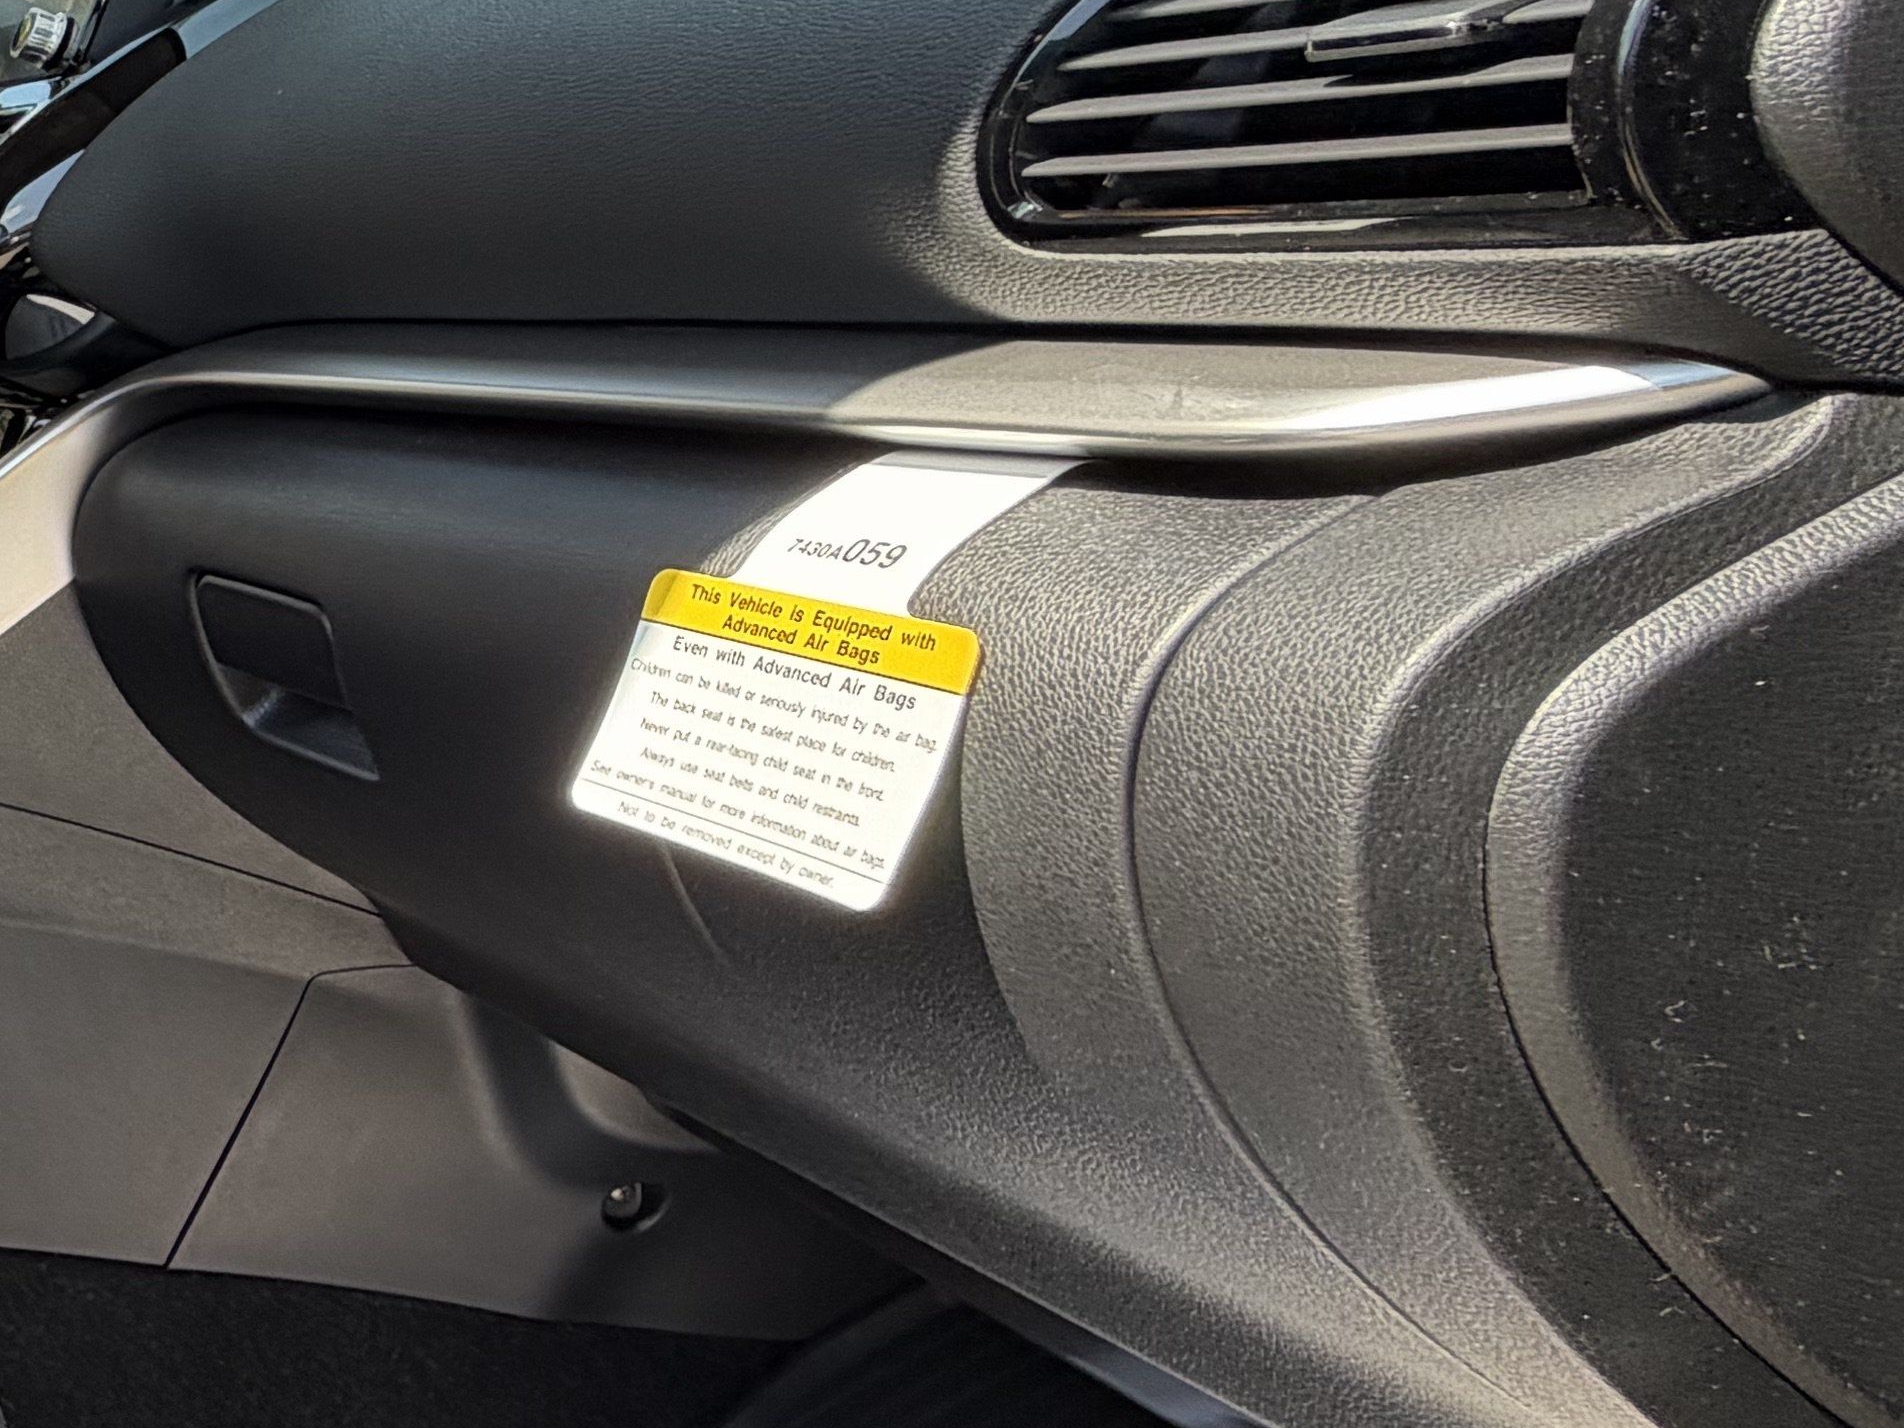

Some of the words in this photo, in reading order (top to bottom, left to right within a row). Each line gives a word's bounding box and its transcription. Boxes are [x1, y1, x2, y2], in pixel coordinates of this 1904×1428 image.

[787, 538, 908, 569] 7430A059
[691, 582, 722, 605] This
[729, 590, 783, 618] Vehicle
[788, 603, 805, 623] is
[811, 608, 893, 641] Equipped
[900, 630, 936, 651] with
[720, 613, 798, 645] Advanced
[802, 631, 829, 652] Air
[835, 638, 880, 666] Bags
[672, 634, 709, 658] Even
[715, 648, 746, 667] with
[751, 655, 832, 688] Advanced
[837, 675, 866, 696] Air
[872, 683, 917, 711] Bags
[650, 689, 669, 707] The
[851, 715, 868, 735] by
